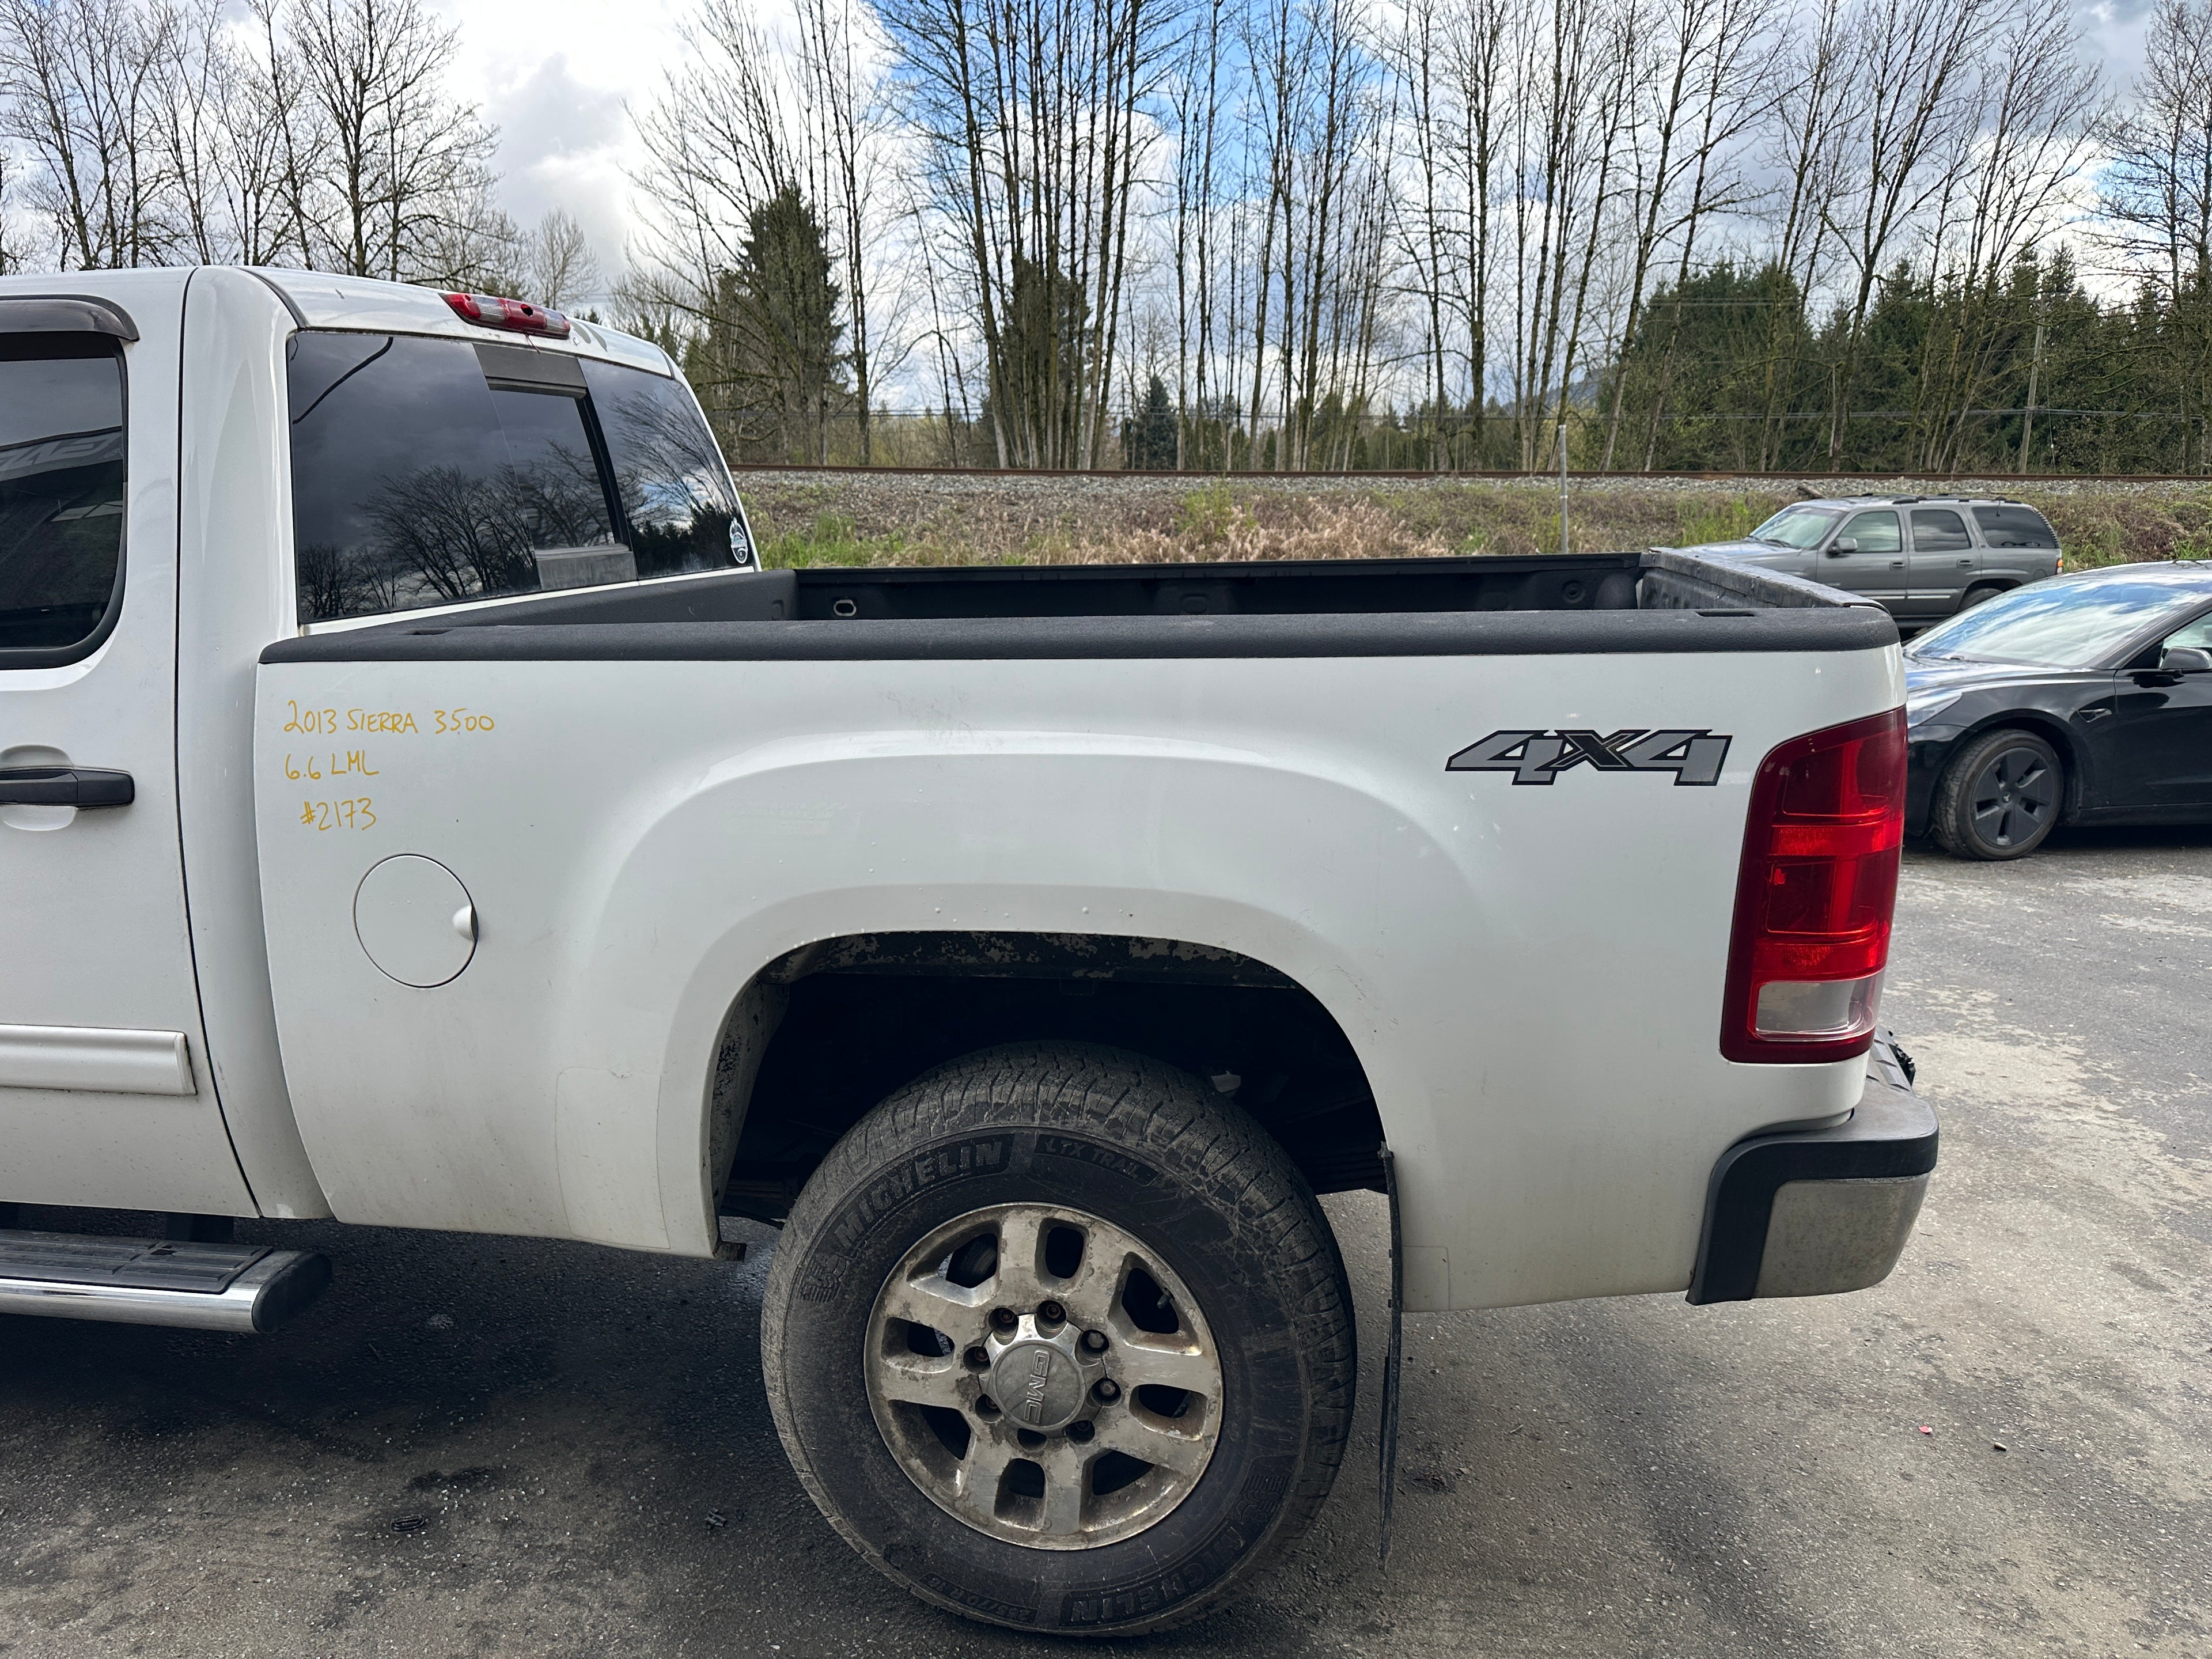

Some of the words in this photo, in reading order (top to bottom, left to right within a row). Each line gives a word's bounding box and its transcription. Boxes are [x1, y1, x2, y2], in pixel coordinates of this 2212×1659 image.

[283, 700, 337, 734] 2013
[347, 709, 418, 734] SIERRA
[434, 708, 495, 734] 3500
[285, 753, 321, 779] 6.6
[331, 749, 380, 775] LML
[300, 797, 376, 831] #2173
[1046, 1138, 1088, 1157] LTX
[1092, 1147, 1140, 1179] TRAIL
[835, 1141, 1002, 1249] MICHELIN
[1024, 1349, 1050, 1423] GMC
[1070, 1525, 1246, 1622] MICHELIN
